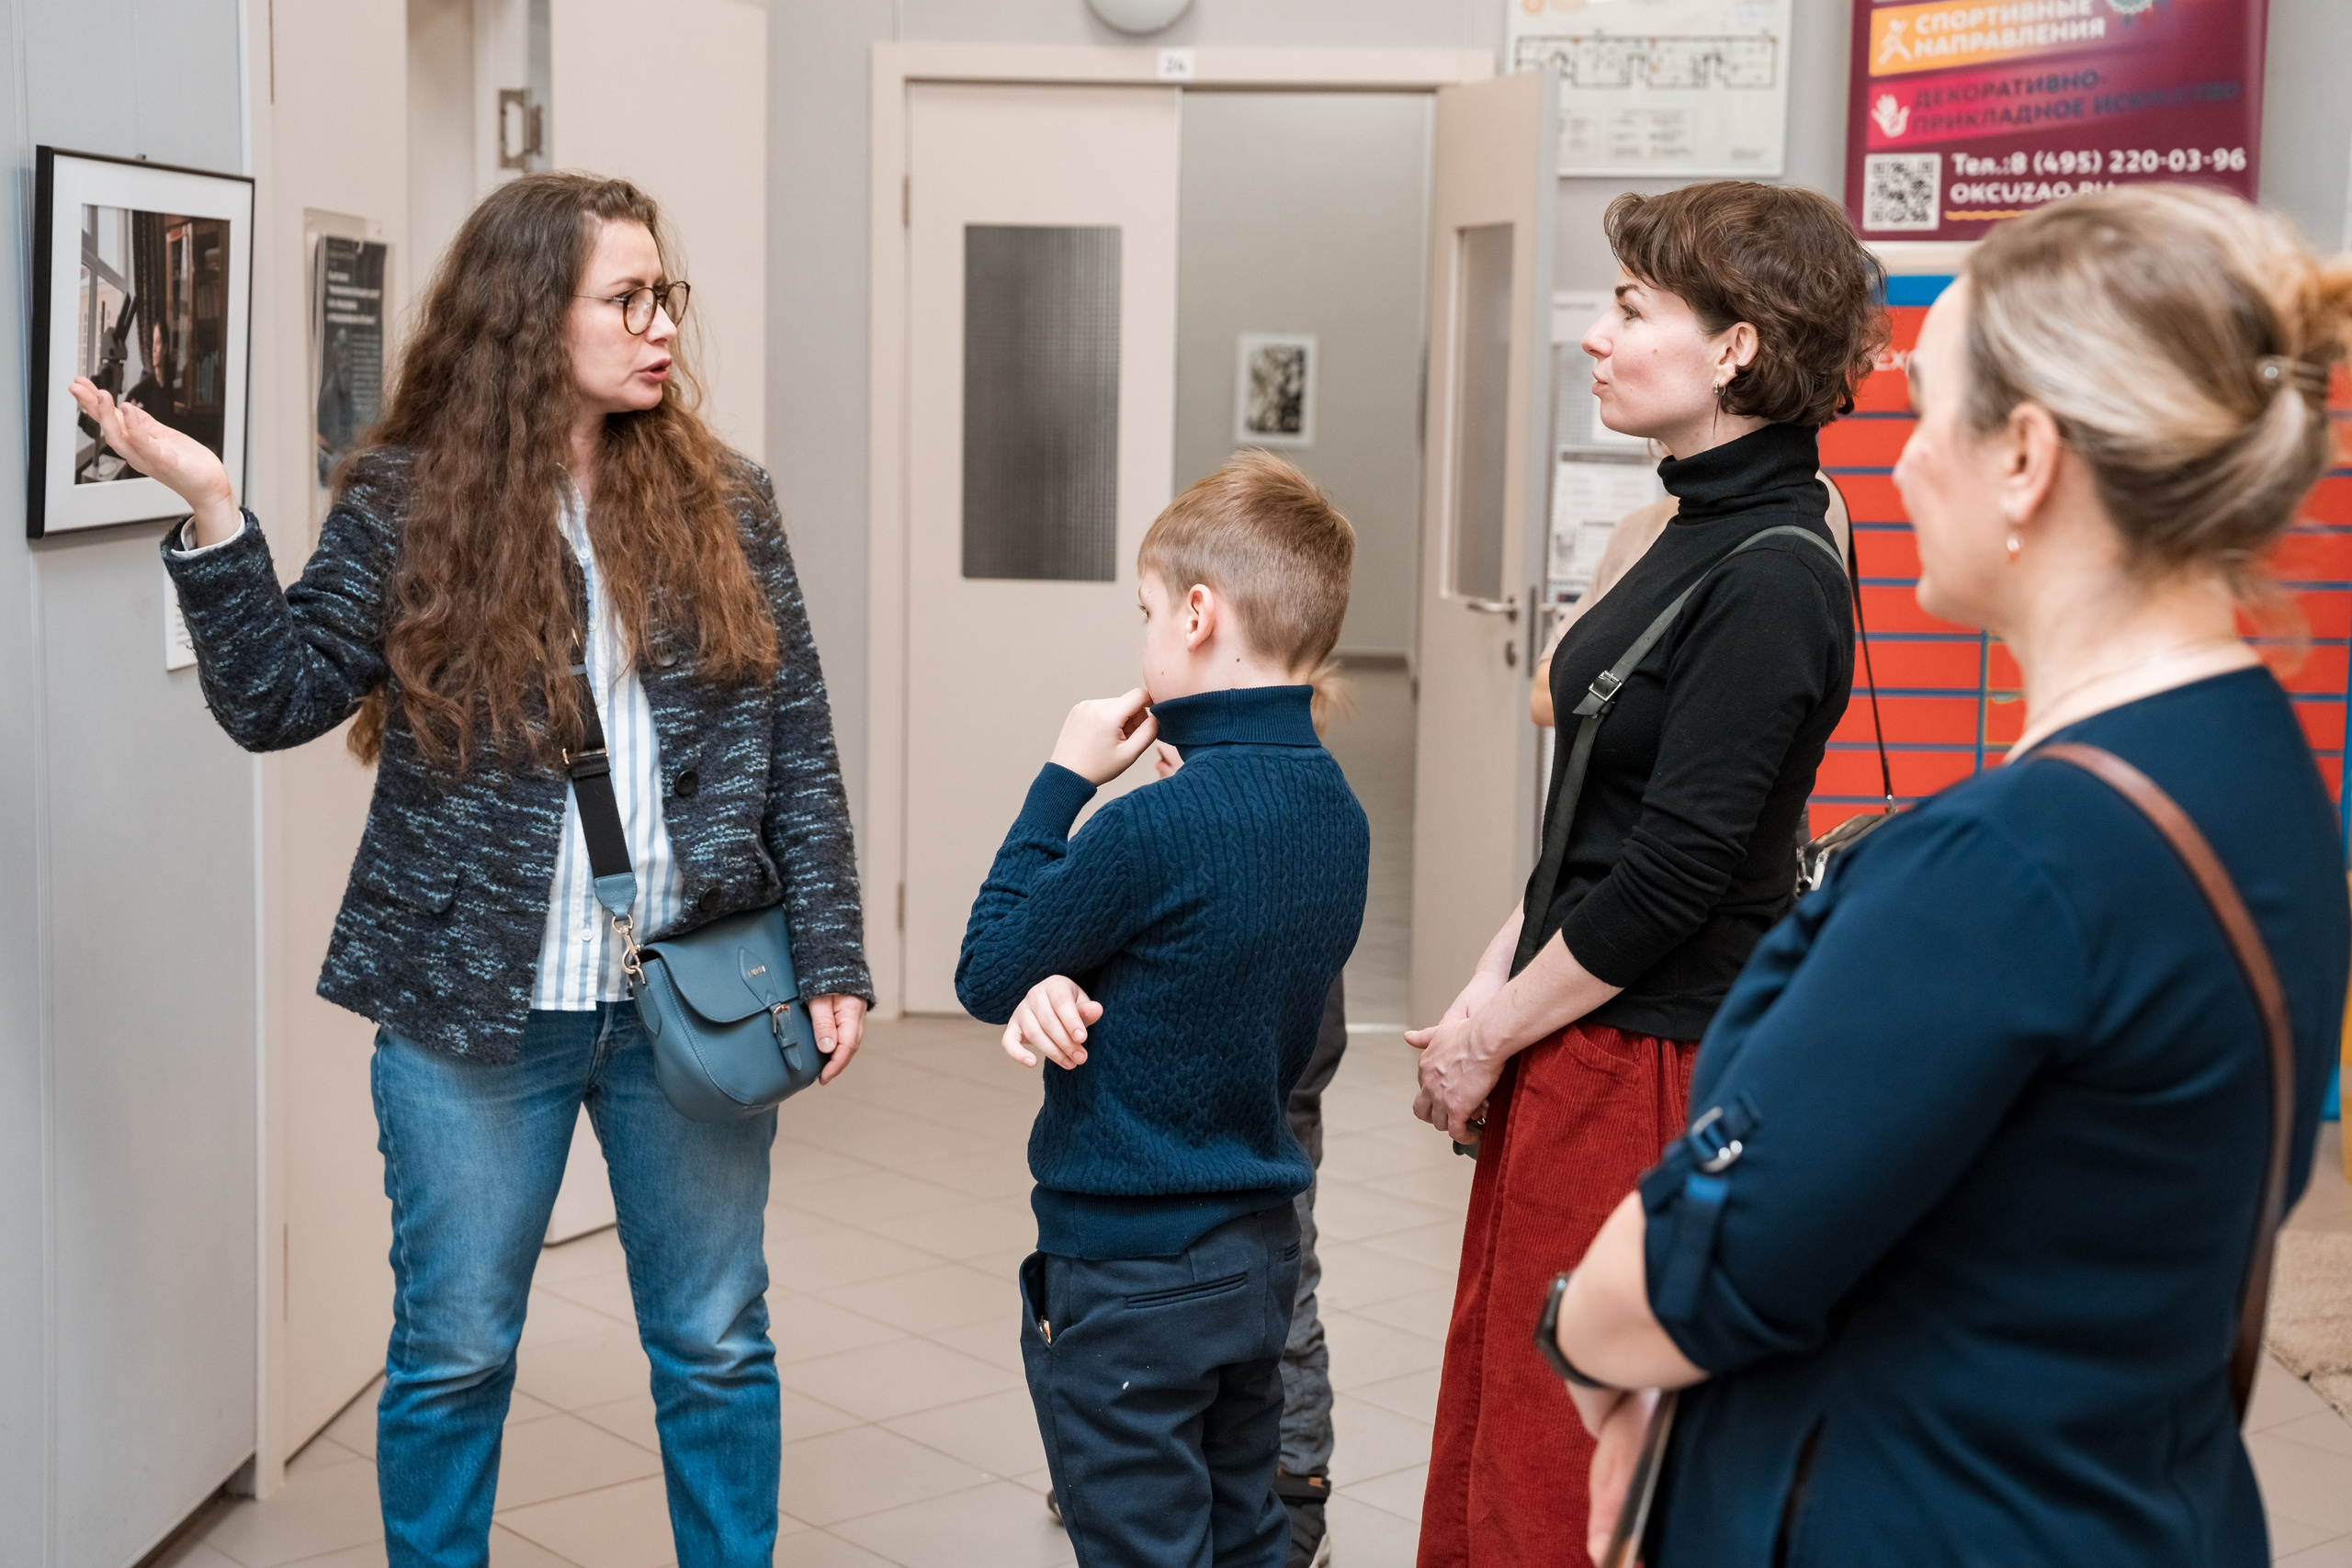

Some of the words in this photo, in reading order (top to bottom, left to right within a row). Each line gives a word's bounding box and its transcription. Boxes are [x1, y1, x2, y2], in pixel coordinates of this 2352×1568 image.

[1916, 0, 2092, 35] СПОРТИВНЫЕ
[1915, 17, 2106, 57] НАПРАВЛЕНИЯ
[1913, 98, 2083, 133] ПРИКЛАДНОЕ
[2033, 149, 2103, 175] (495)
[2109, 147, 2247, 174] 220-03-96
